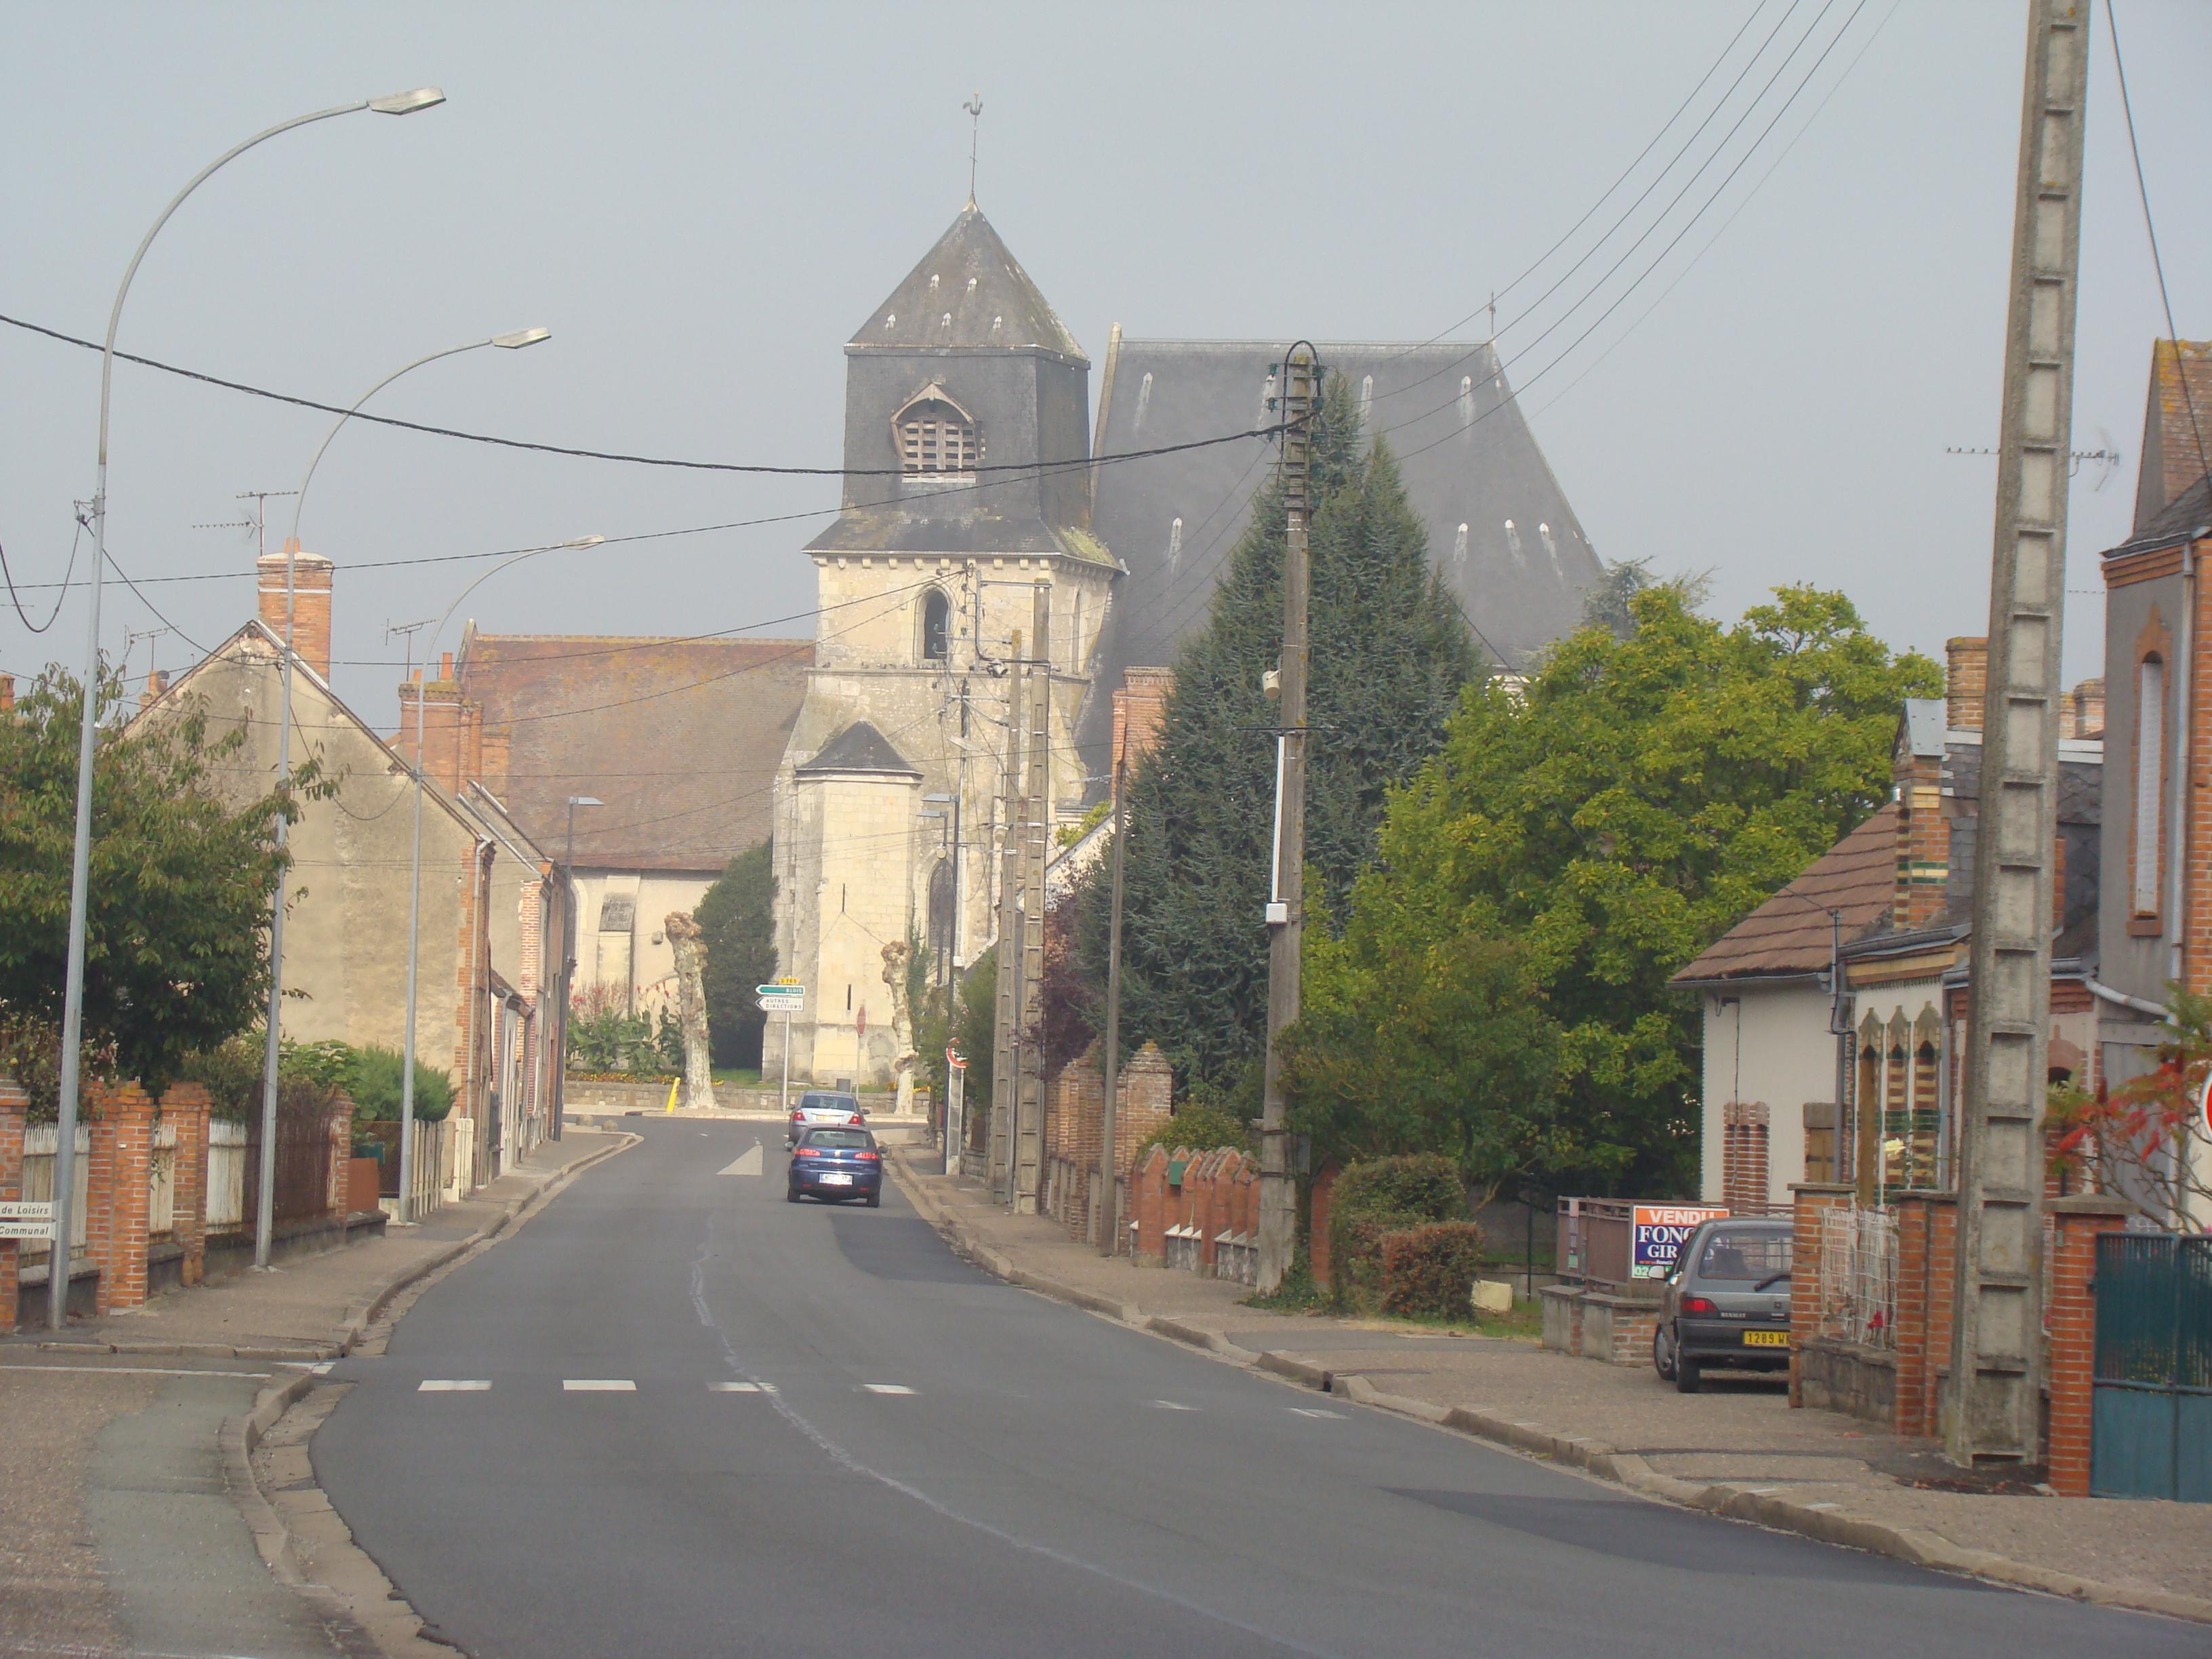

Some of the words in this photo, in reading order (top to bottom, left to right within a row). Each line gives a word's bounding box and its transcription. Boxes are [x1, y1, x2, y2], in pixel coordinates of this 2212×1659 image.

[1, 1206, 12, 1214] de
[18, 1206, 48, 1214] Loisirs
[1649, 1210, 1715, 1224] VENDU
[0, 1226, 49, 1235] Communal
